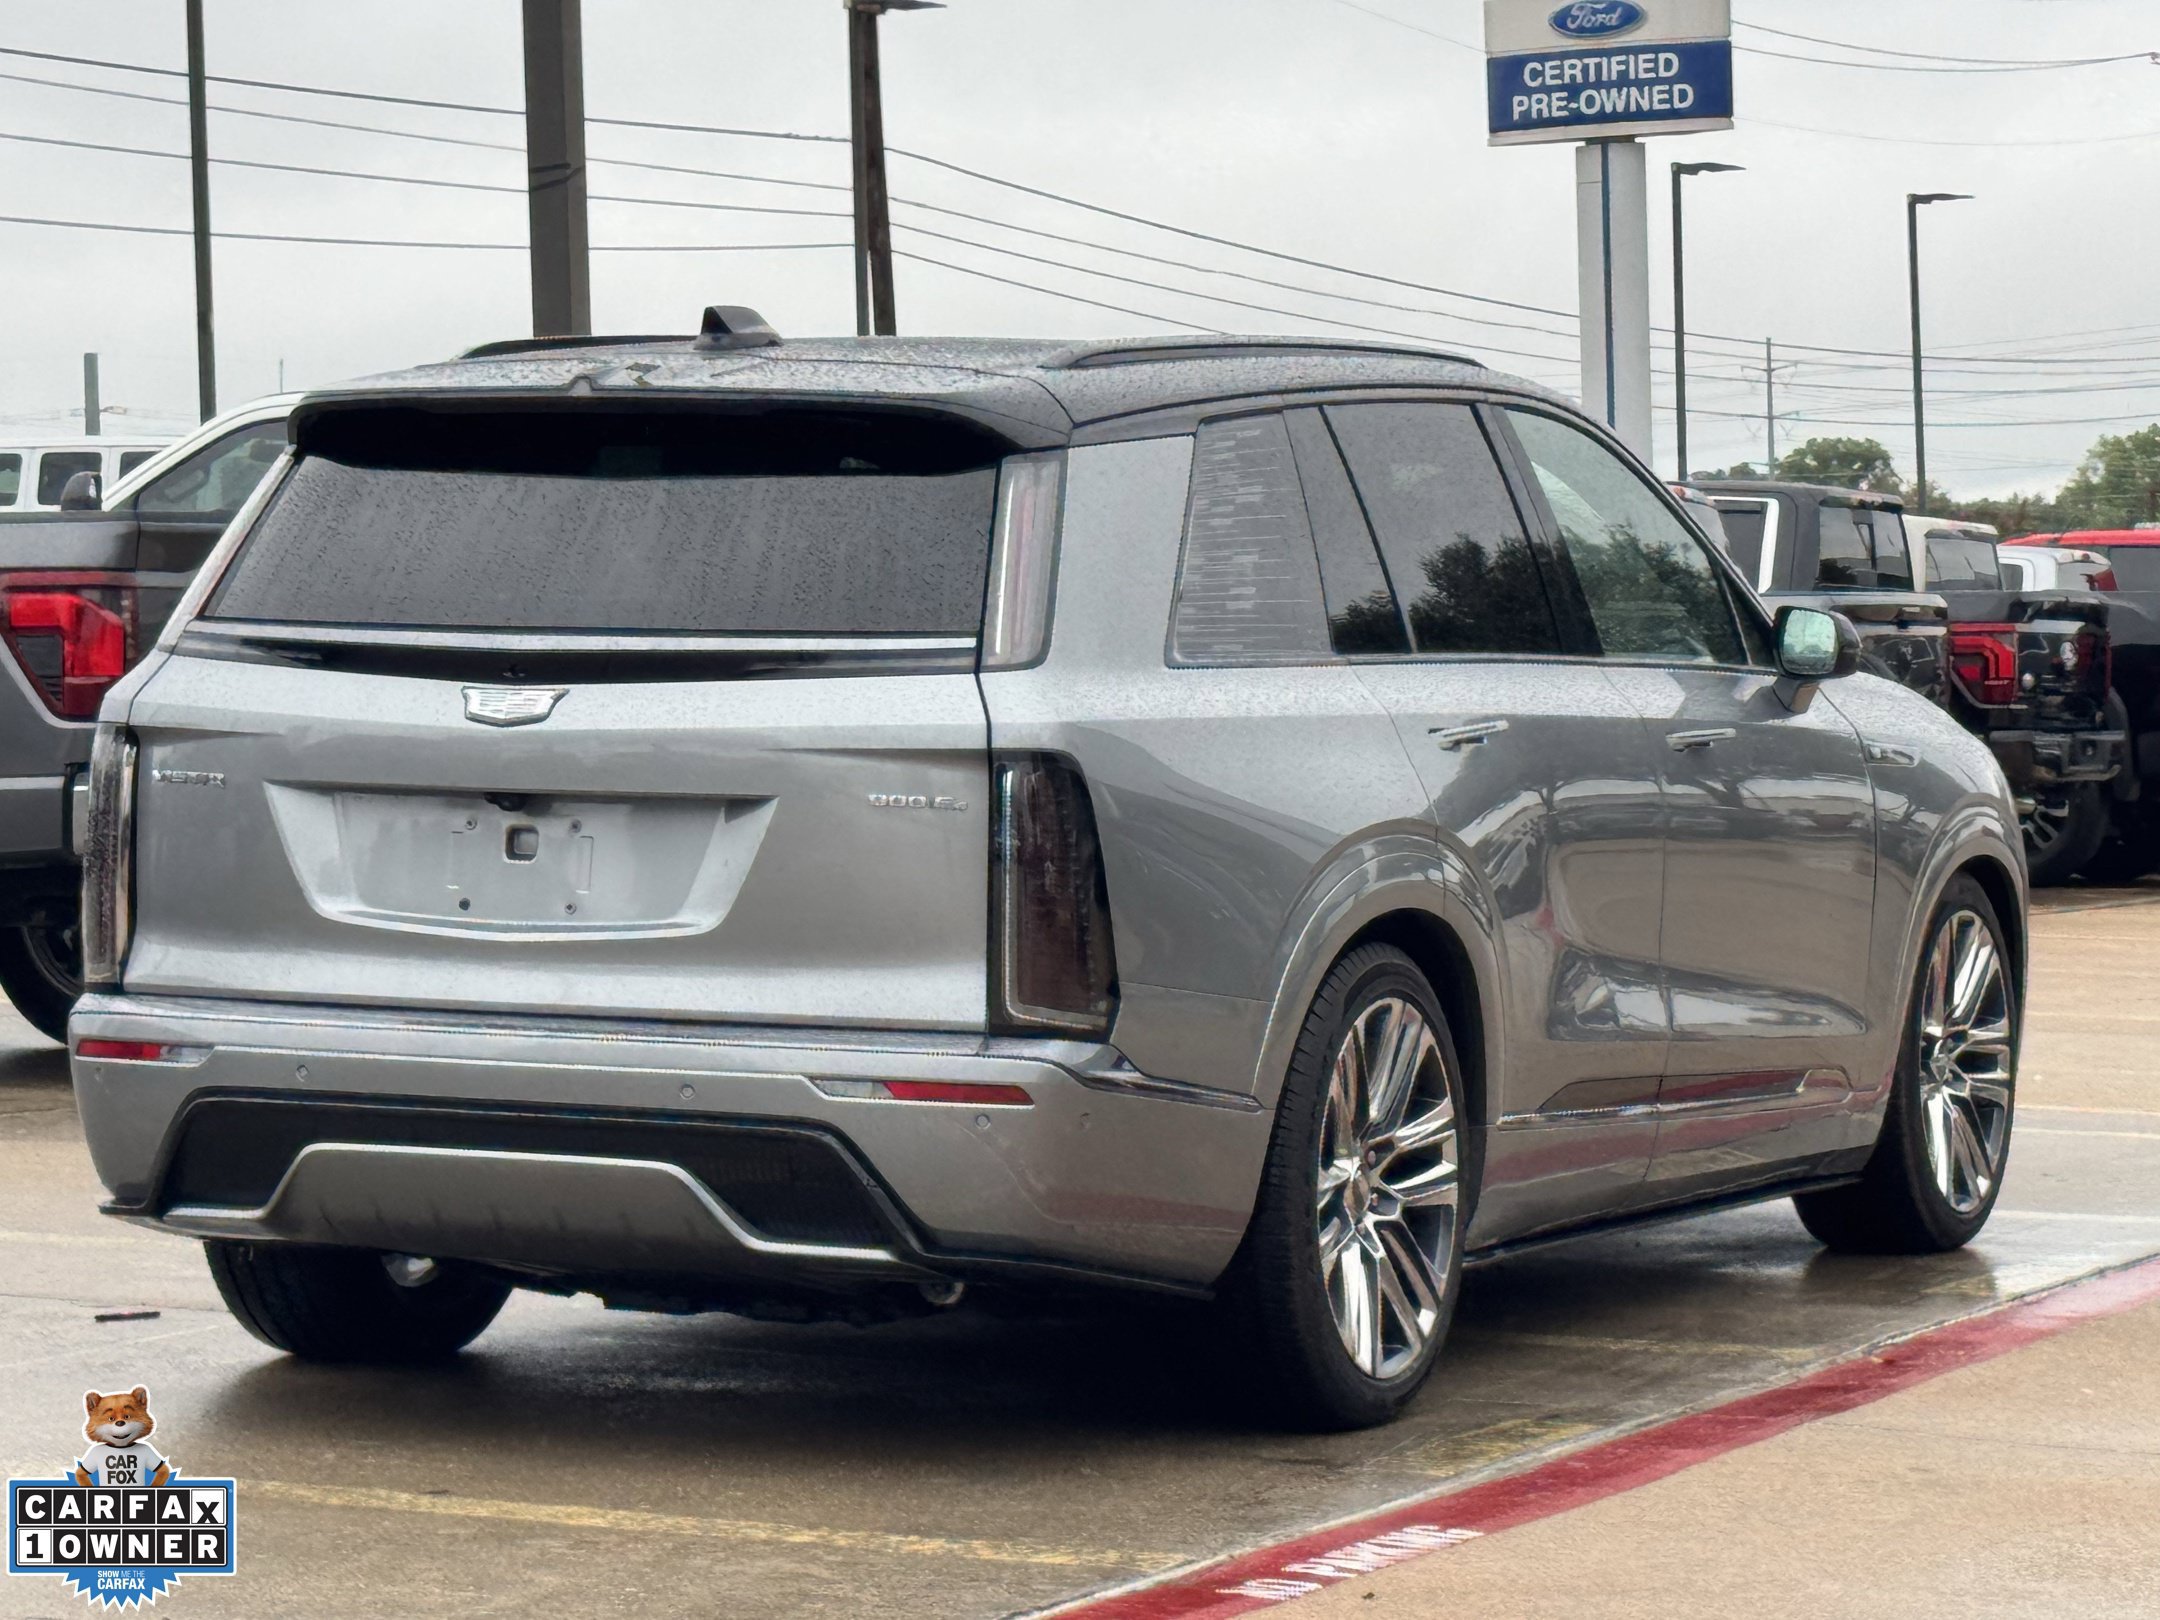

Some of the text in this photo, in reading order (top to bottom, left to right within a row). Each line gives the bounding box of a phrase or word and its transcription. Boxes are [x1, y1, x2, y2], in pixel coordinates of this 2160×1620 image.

[1566, 3, 1623, 29] Ford
[1523, 52, 1680, 88] CERTIFIED
[1512, 83, 1695, 121] PRE-OWNED
